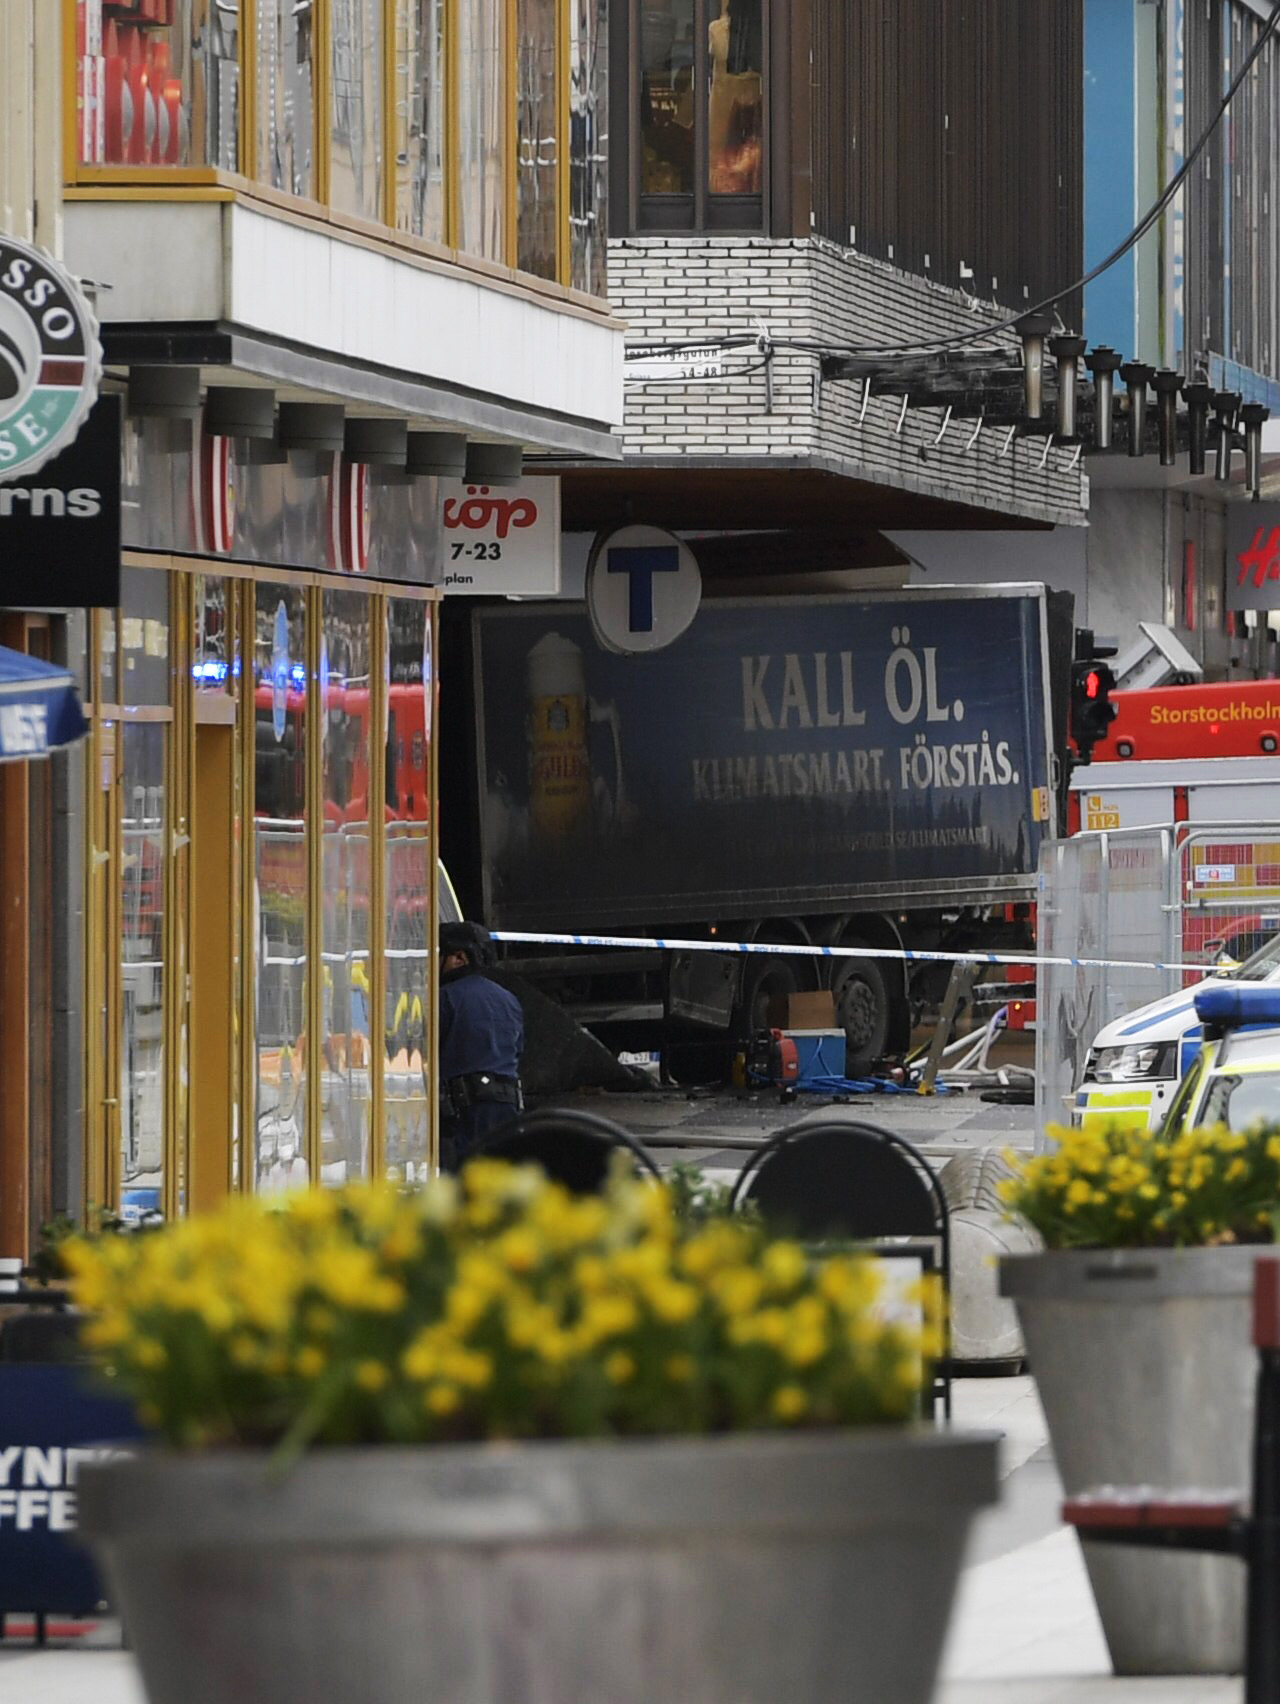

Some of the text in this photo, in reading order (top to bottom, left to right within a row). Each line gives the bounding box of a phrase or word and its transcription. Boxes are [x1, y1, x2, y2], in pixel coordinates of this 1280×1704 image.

[0, 256, 75, 341] SSO
[442, 572, 473, 584] plan
[451, 542, 502, 561] 7-23
[607, 545, 679, 633] T
[740, 626, 965, 732] KALL ÖL.
[692, 728, 1020, 801] KLIMATSMART. FÖRSTÅS.
[1090, 814, 1118, 828] 112
